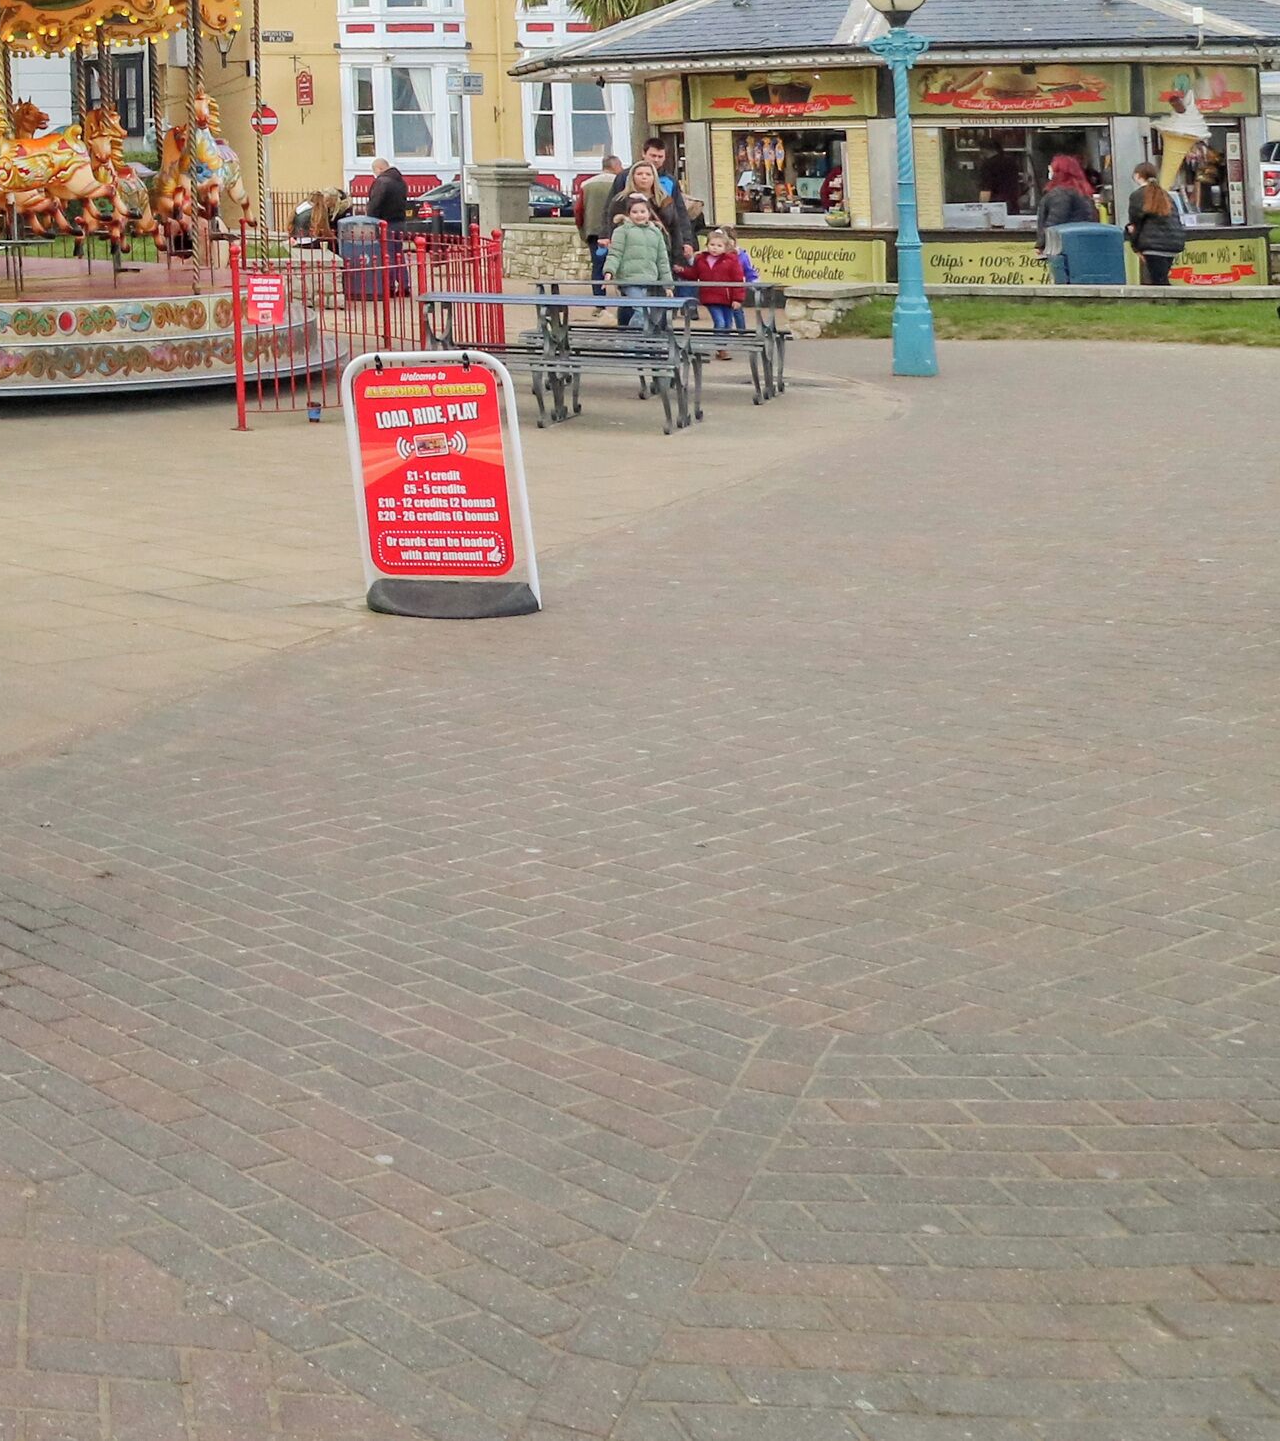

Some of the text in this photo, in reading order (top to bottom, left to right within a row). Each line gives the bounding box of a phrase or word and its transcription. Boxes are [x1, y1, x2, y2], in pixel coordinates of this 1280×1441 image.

[750, 245, 856, 265] Coffee Cappuccino
[930, 254, 964, 271] Chips
[980, 256, 1015, 268] 100%
[771, 265, 790, 278] Hot
[792, 266, 845, 280] Chocolate
[942, 272, 985, 285] Bacon
[990, 272, 1025, 285] Rolls
[400, 372, 446, 382] Welcome to
[432, 383, 487, 397] GARDENS
[375, 402, 478, 429] LOAD, RIDE, PLAY
[406, 470, 419, 481] £1
[425, 470, 430, 481] 1
[431, 470, 461, 481] credit
[403, 484, 417, 495] £5
[423, 484, 430, 495] 5
[431, 484, 467, 495] credits
[378, 497, 395, 508] £10
[401, 497, 413, 508] 12
[414, 497, 449, 508] credits
[377, 510, 396, 521] £20
[402, 510, 415, 521] 26
[416, 510, 451, 521] credits
[386, 536, 496, 547] Or cards can be loaded
[401, 550, 483, 562] with any amount!
